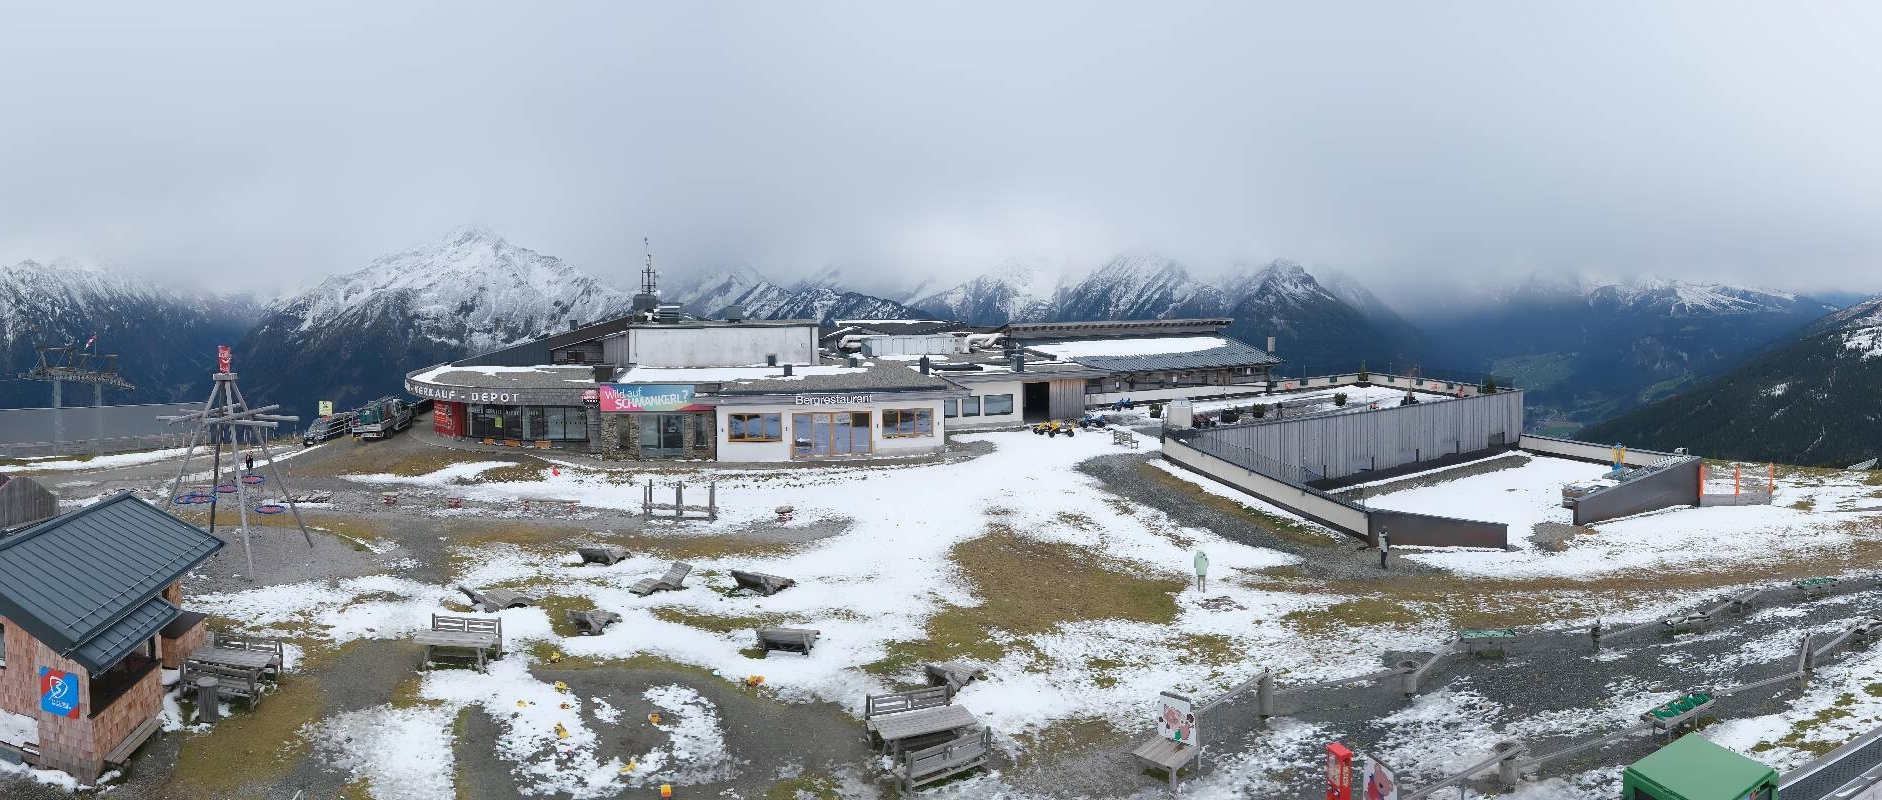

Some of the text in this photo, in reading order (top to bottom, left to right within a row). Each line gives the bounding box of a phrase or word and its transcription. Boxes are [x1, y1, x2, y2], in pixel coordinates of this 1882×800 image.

[414, 385, 456, 400] VERKAUF
[471, 392, 520, 402] DEPOT
[605, 388, 626, 400] Wild
[627, 387, 642, 397] auf
[795, 394, 874, 406] Bergrestaurant
